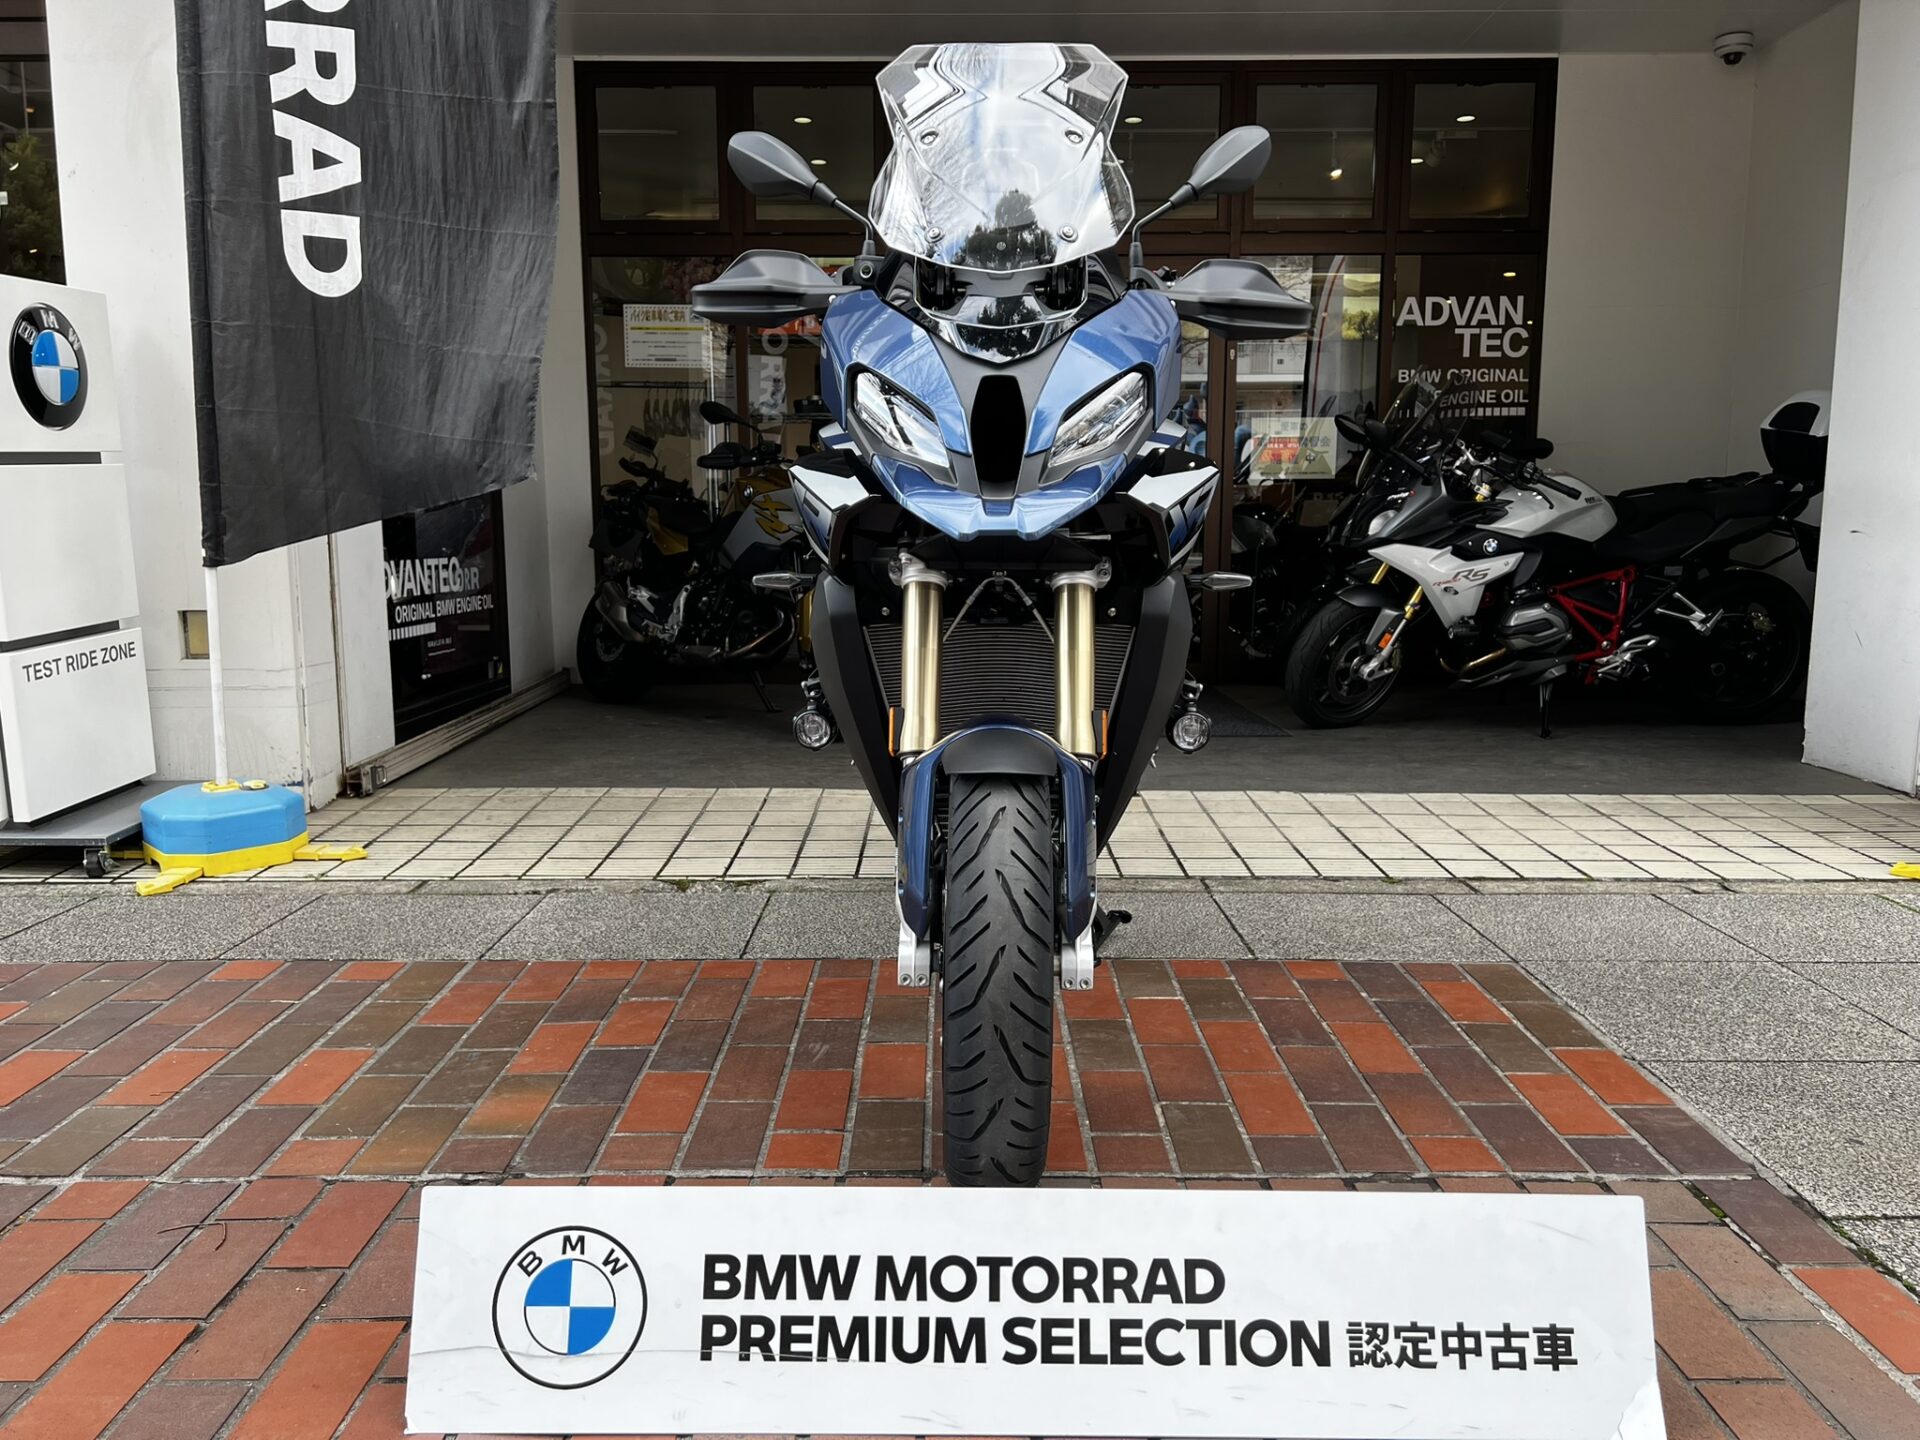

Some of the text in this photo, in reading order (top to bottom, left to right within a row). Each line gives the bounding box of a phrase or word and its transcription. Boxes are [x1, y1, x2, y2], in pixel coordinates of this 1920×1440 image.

[264, 0, 362, 298] RAD
[18, 309, 81, 351] BMW
[1396, 295, 1524, 326] ADVAN
[1455, 327, 1529, 358] TEC
[1398, 368, 1529, 385] BMW ORIGINAL
[1501, 389, 1529, 403] OIL
[1451, 567, 1491, 582] RS
[395, 601, 435, 623] ORIGINAL
[436, 599, 455, 617] BMW
[456, 595, 482, 614] ENGINE
[22, 641, 136, 682] TEST RIDE ZONE
[517, 1235, 629, 1277] BMW
[702, 1255, 1225, 1300] BMW MOTORRAD
[701, 1315, 1330, 1367] PREMIUM SELECTION
[1346, 1321, 1579, 1371] 認定中古車
